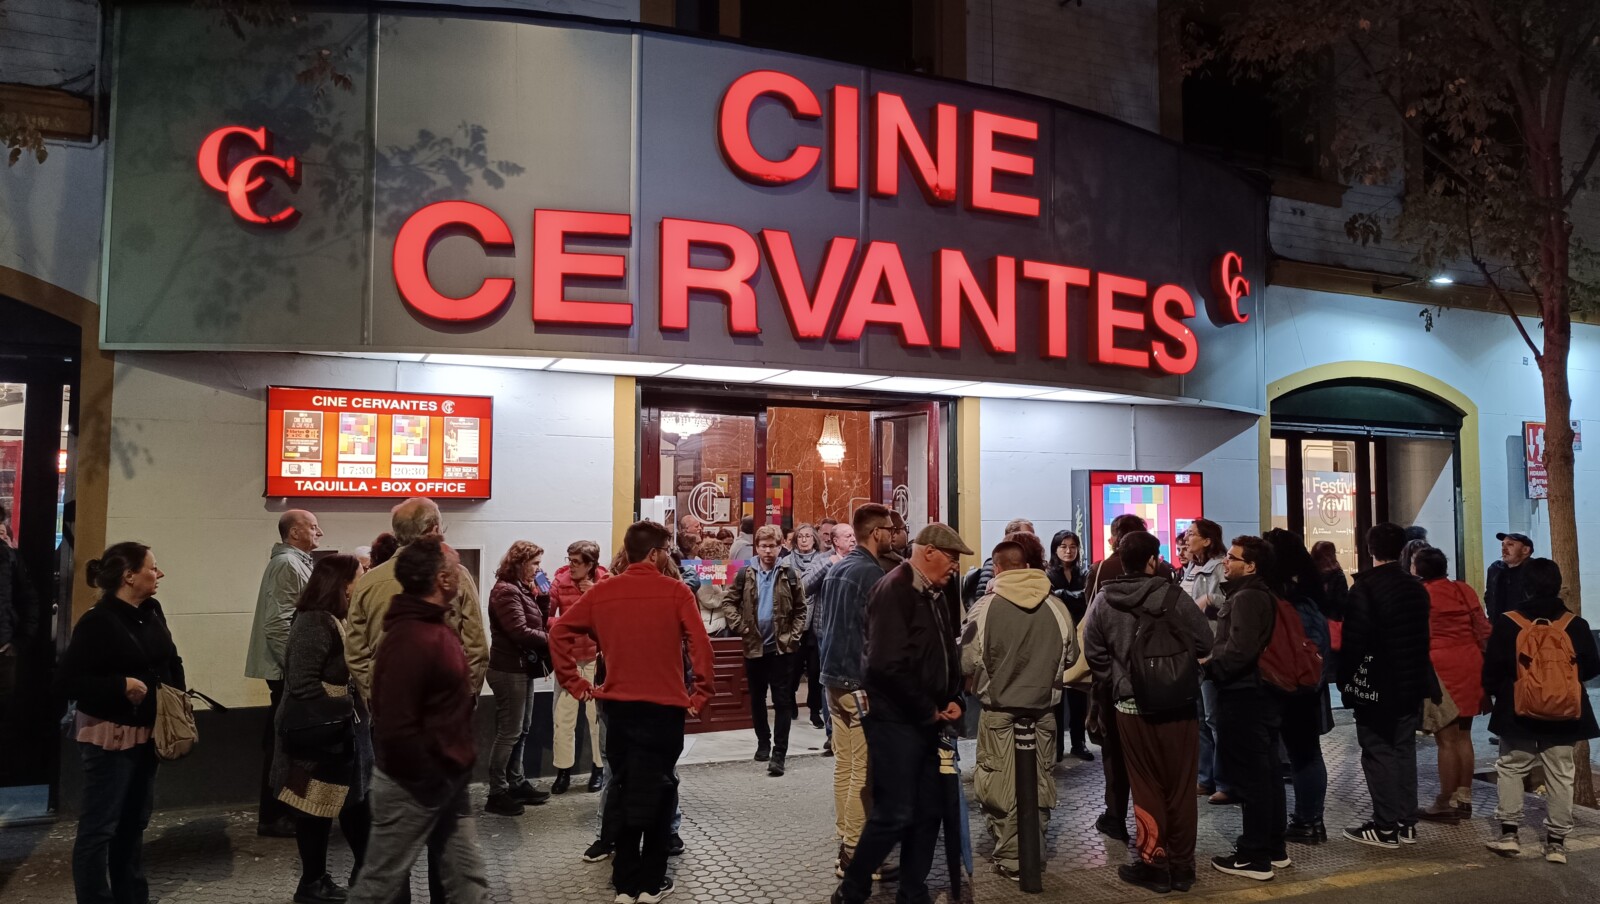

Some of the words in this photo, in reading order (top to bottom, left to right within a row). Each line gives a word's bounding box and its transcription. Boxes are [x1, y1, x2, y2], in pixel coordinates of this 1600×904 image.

[718, 69, 1040, 218] CINE
[392, 199, 1199, 375] CERVANTES
[312, 395, 348, 407] CINE
[351, 397, 438, 411] CERVANTES
[342, 466, 373, 476] 17:30
[394, 467, 425, 476] 20:30
[1116, 474, 1156, 483] EVENTOS
[294, 480, 368, 492] TAQUILLA
[381, 481, 411, 493] BOX
[414, 482, 466, 494] OFFICE
[697, 564, 728, 572] Festival
[699, 572, 728, 580] Sevilla
